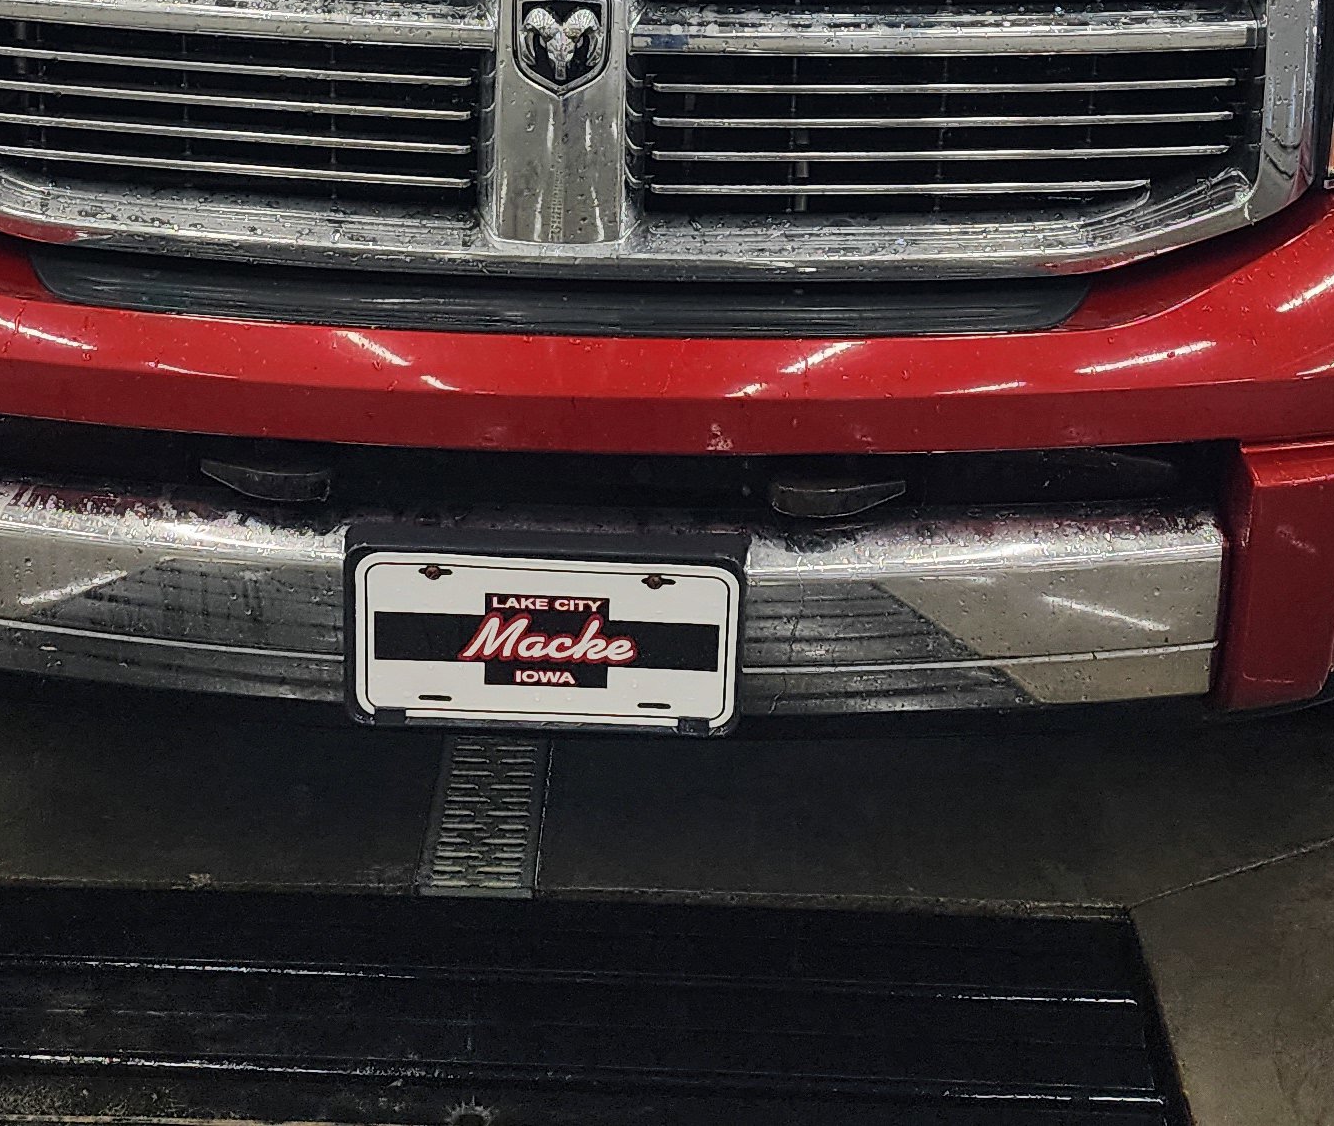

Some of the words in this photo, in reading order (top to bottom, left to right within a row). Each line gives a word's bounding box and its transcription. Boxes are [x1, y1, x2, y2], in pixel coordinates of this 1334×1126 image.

[492, 597, 549, 610] LAKE
[554, 599, 602, 612] CITY
[461, 614, 636, 662] Macke
[515, 670, 576, 685] IOWA
